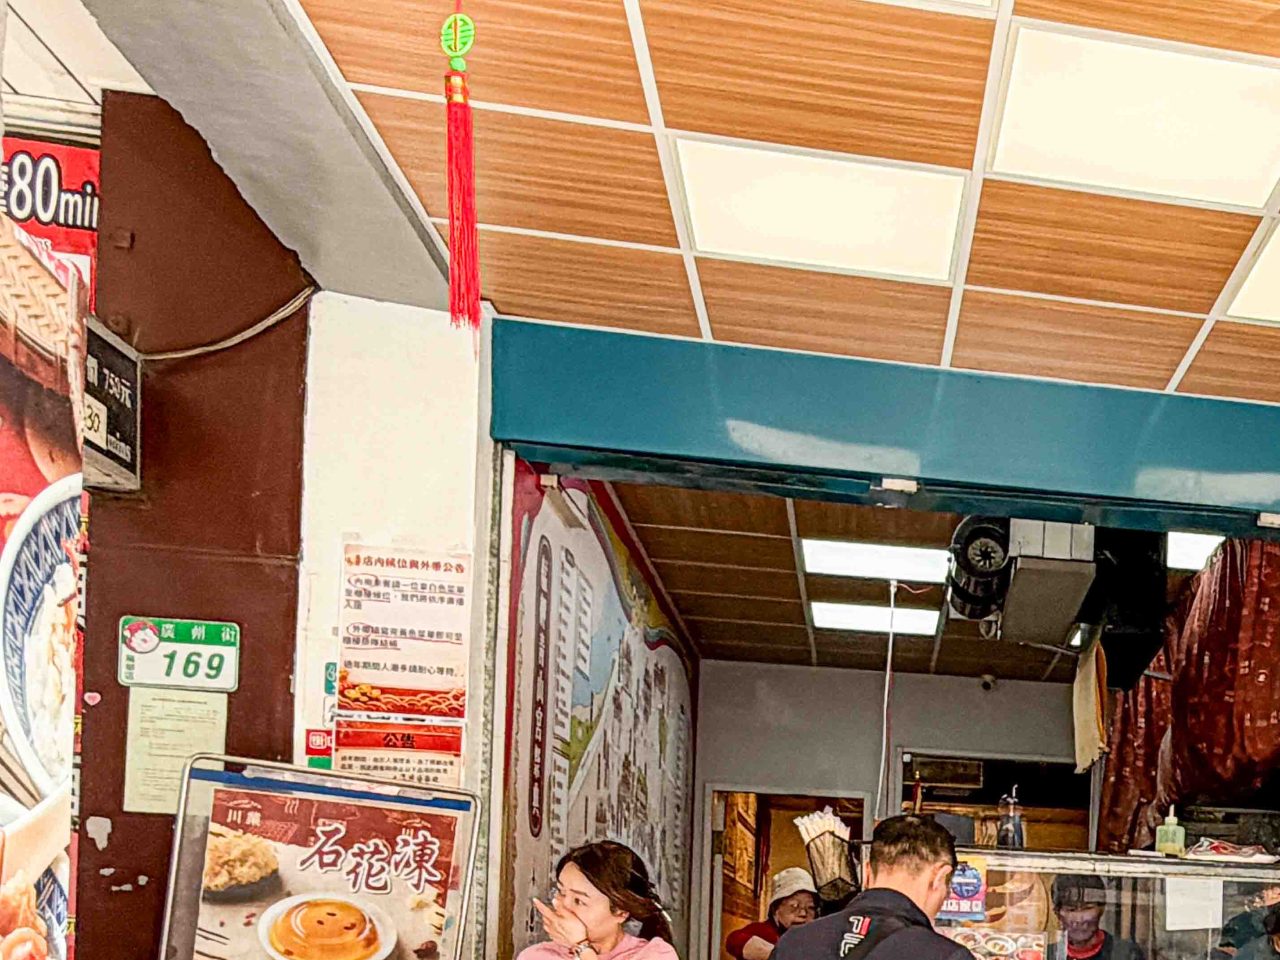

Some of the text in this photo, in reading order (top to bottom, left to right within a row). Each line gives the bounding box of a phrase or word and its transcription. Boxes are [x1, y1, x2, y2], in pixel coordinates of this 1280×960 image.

[163, 650, 225, 680] 169
[299, 823, 443, 894] 石花凍
